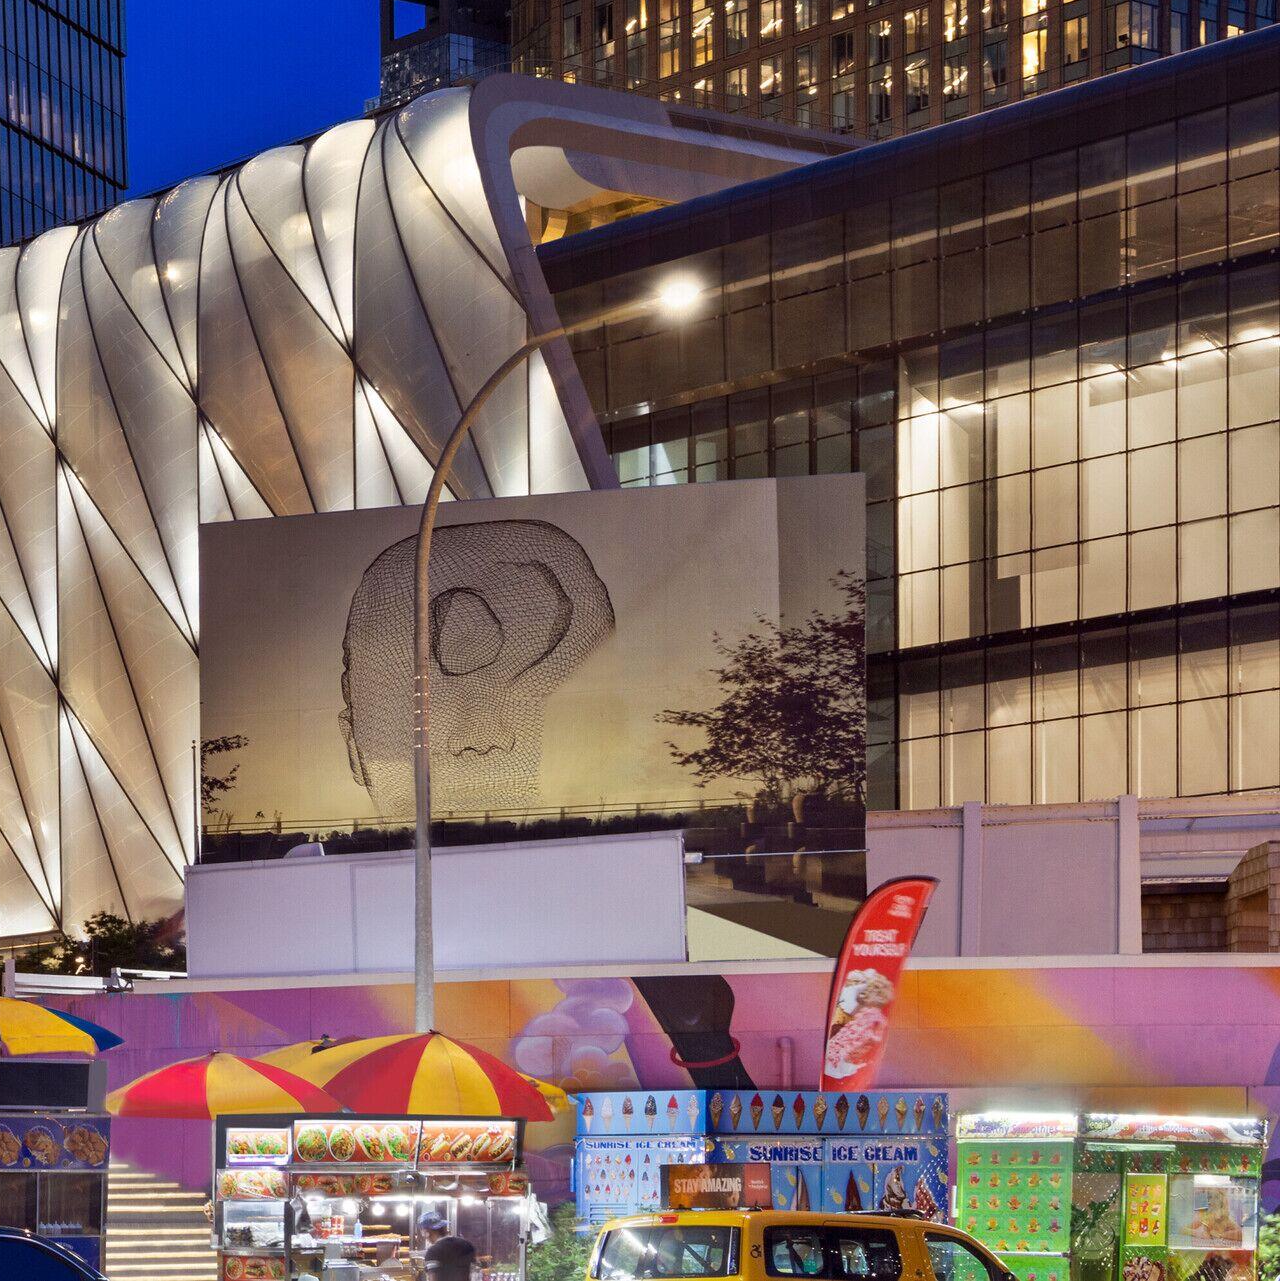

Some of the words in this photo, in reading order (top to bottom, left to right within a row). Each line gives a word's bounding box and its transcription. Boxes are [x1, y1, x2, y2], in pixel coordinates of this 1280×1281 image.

[585, 1141, 631, 1149] SUNRISE
[635, 1141, 653, 1149] ICE
[657, 1140, 696, 1149] CREAM
[750, 1145, 824, 1161] SUNRISE
[831, 1145, 858, 1161] ICE
[864, 1145, 918, 1161] CREAM
[674, 1178, 699, 1194] STAY
[700, 1177, 742, 1193] AMAZING
